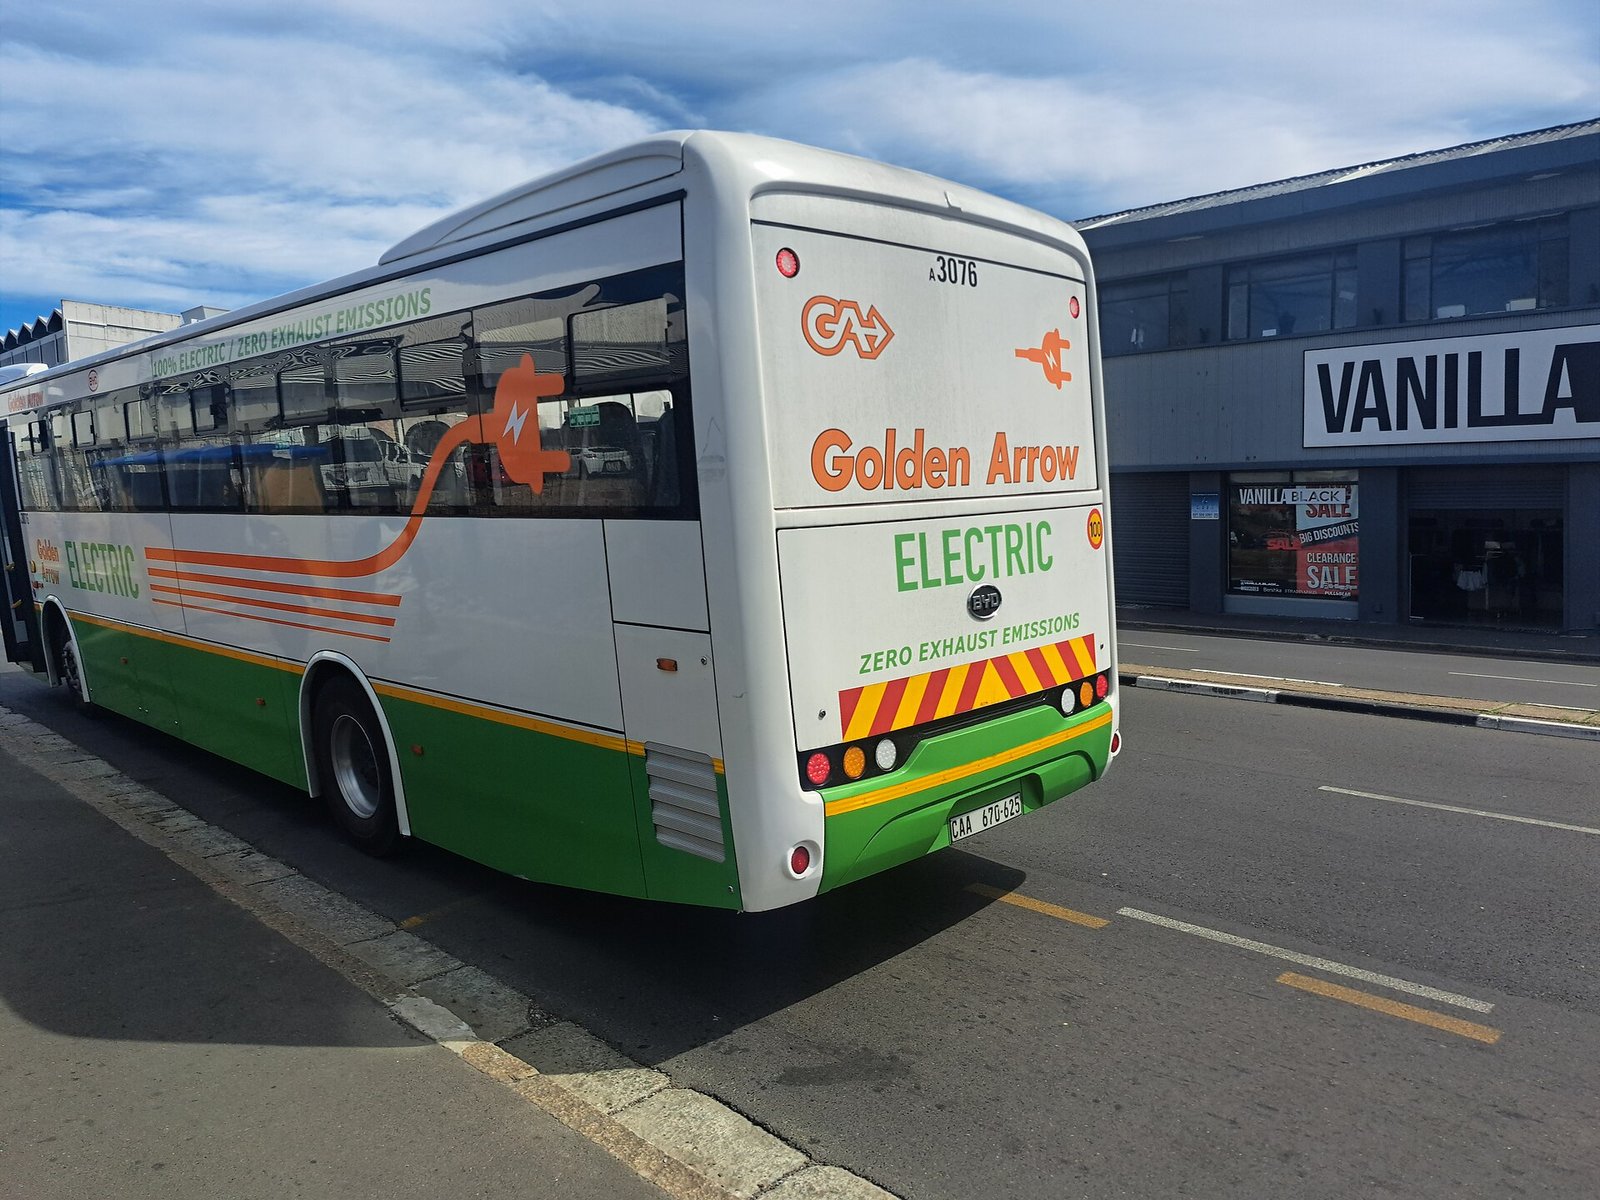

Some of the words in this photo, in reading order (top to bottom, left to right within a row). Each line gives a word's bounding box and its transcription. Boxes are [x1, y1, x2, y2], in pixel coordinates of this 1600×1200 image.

[153, 356, 177, 378] 100%
[179, 342, 226, 371] ELECTRIC
[228, 340, 234, 361] /
[237, 331, 268, 356] ZERO
[271, 314, 333, 348] EXHAUST
[336, 287, 432, 334] EMISSIONS
[1316, 344, 1578, 434] VANILLA
[811, 428, 970, 491] Golden
[986, 431, 1079, 485] Arrow
[1239, 488, 1287, 505] VANILLA
[1291, 490, 1341, 502] BLACK
[1090, 521, 1101, 538] 100
[1299, 531, 1313, 544] BIG
[1314, 521, 1359, 541] DISCOUNTS
[37, 539, 60, 562] Golden
[894, 520, 1053, 592] ELECTRIC
[1307, 552, 1357, 564] CLEARANCE
[41, 561, 60, 584] Arrow
[65, 541, 139, 599] ELECTRIC
[1307, 565, 1358, 589] SALE
[972, 592, 999, 611] BYD
[859, 646, 913, 675] ZERO
[919, 630, 998, 662] EXHAUST
[1002, 612, 1080, 645] EMISSIONS
[952, 815, 972, 839] CAA
[982, 795, 1020, 827] 670-625
